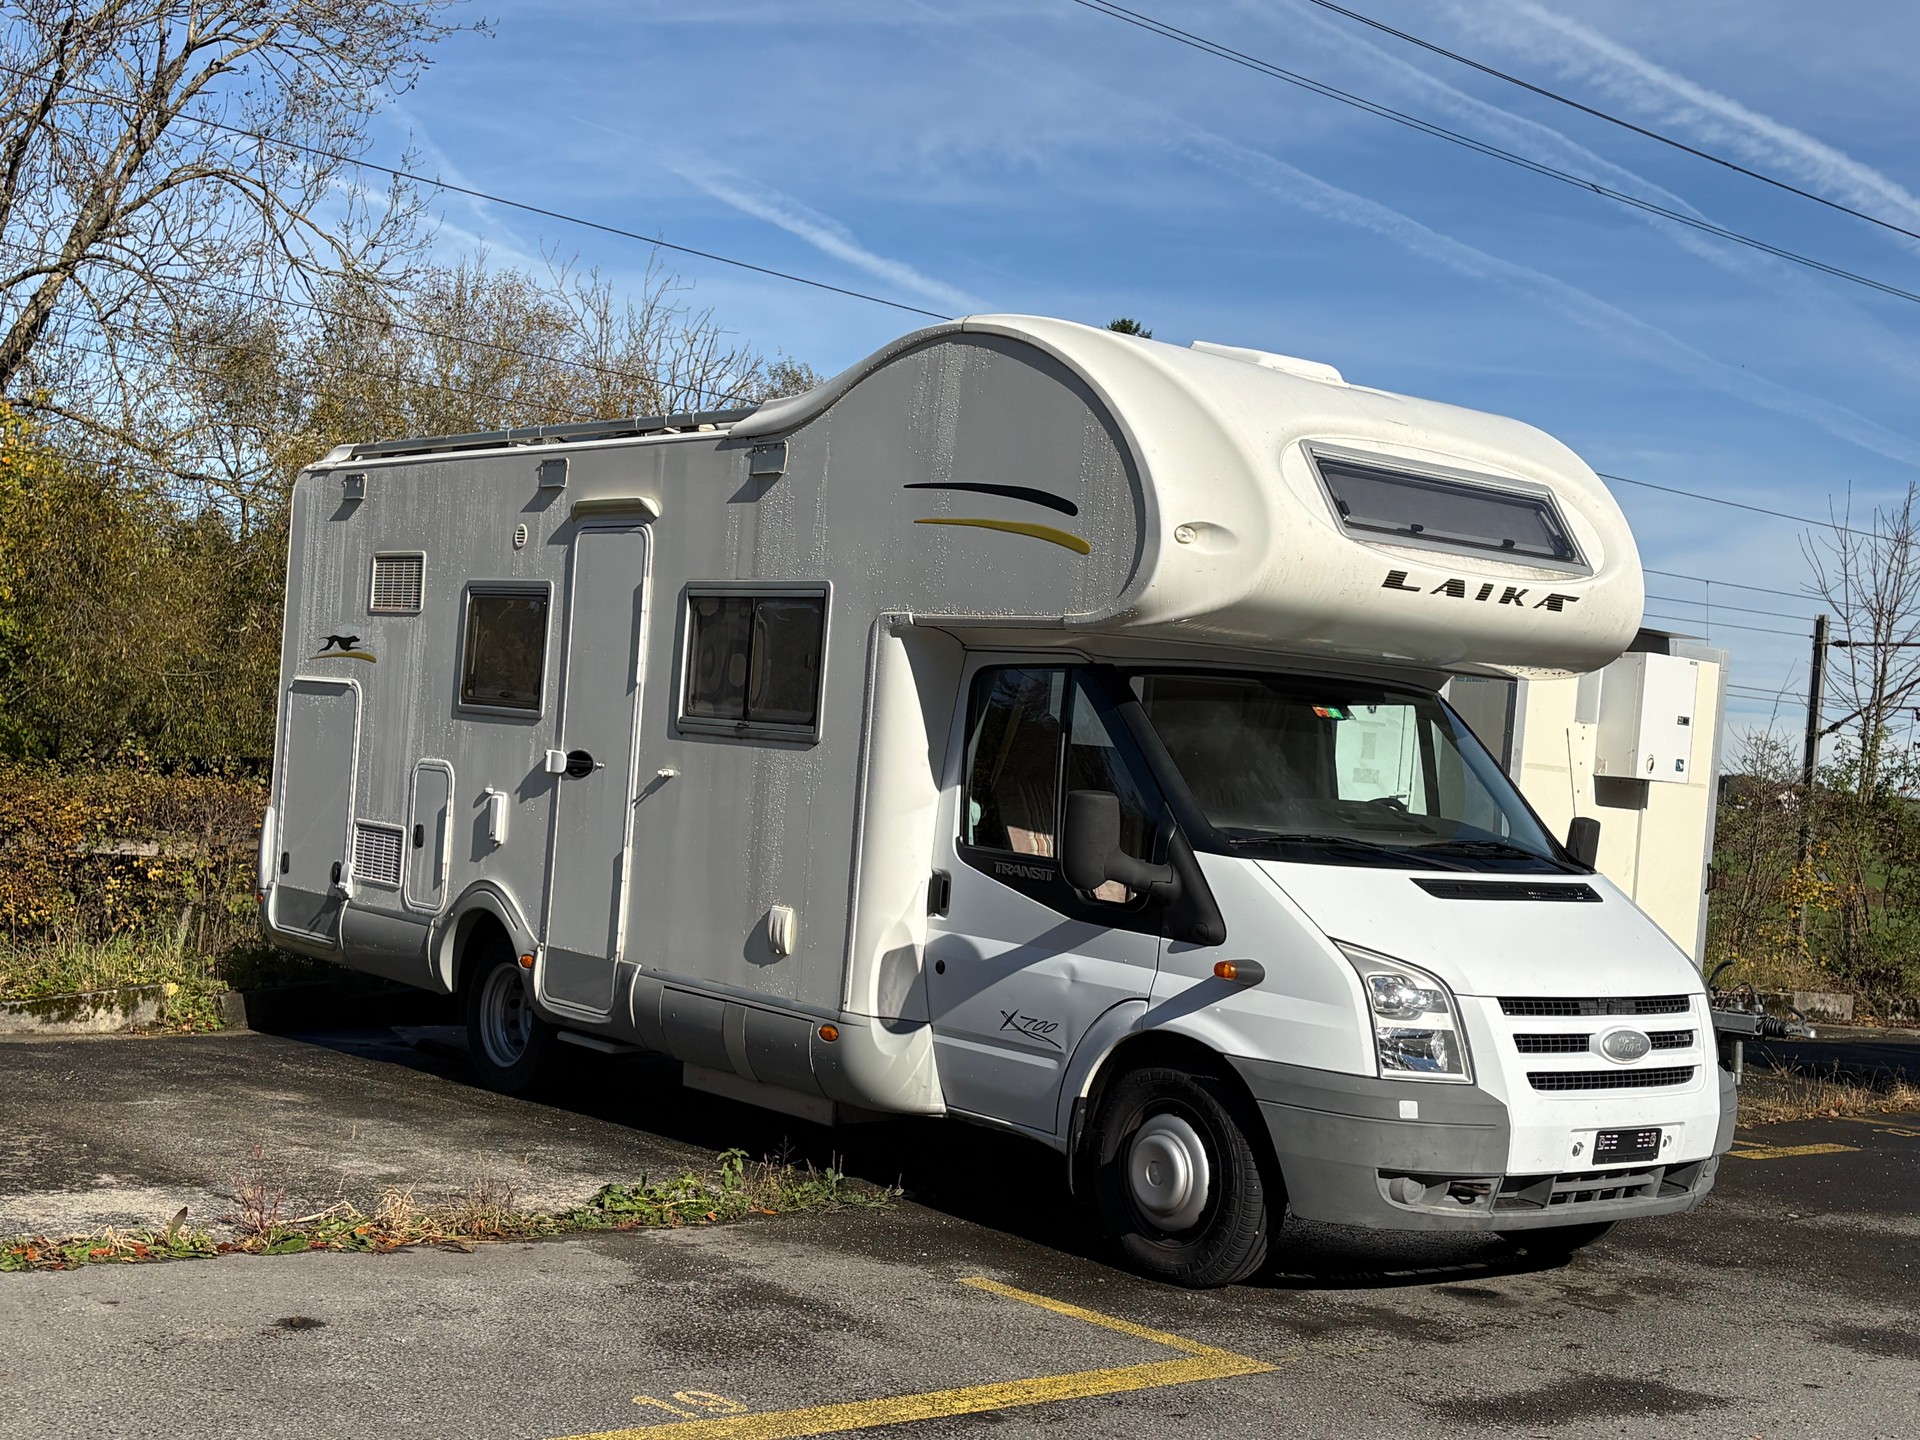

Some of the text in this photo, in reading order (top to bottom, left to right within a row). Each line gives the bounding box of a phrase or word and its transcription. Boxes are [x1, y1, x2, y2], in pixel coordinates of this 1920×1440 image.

[1381, 569, 1581, 612] LAIKA
[994, 861, 1055, 881] TRANSIT
[1617, 1035, 1643, 1054] Ford
